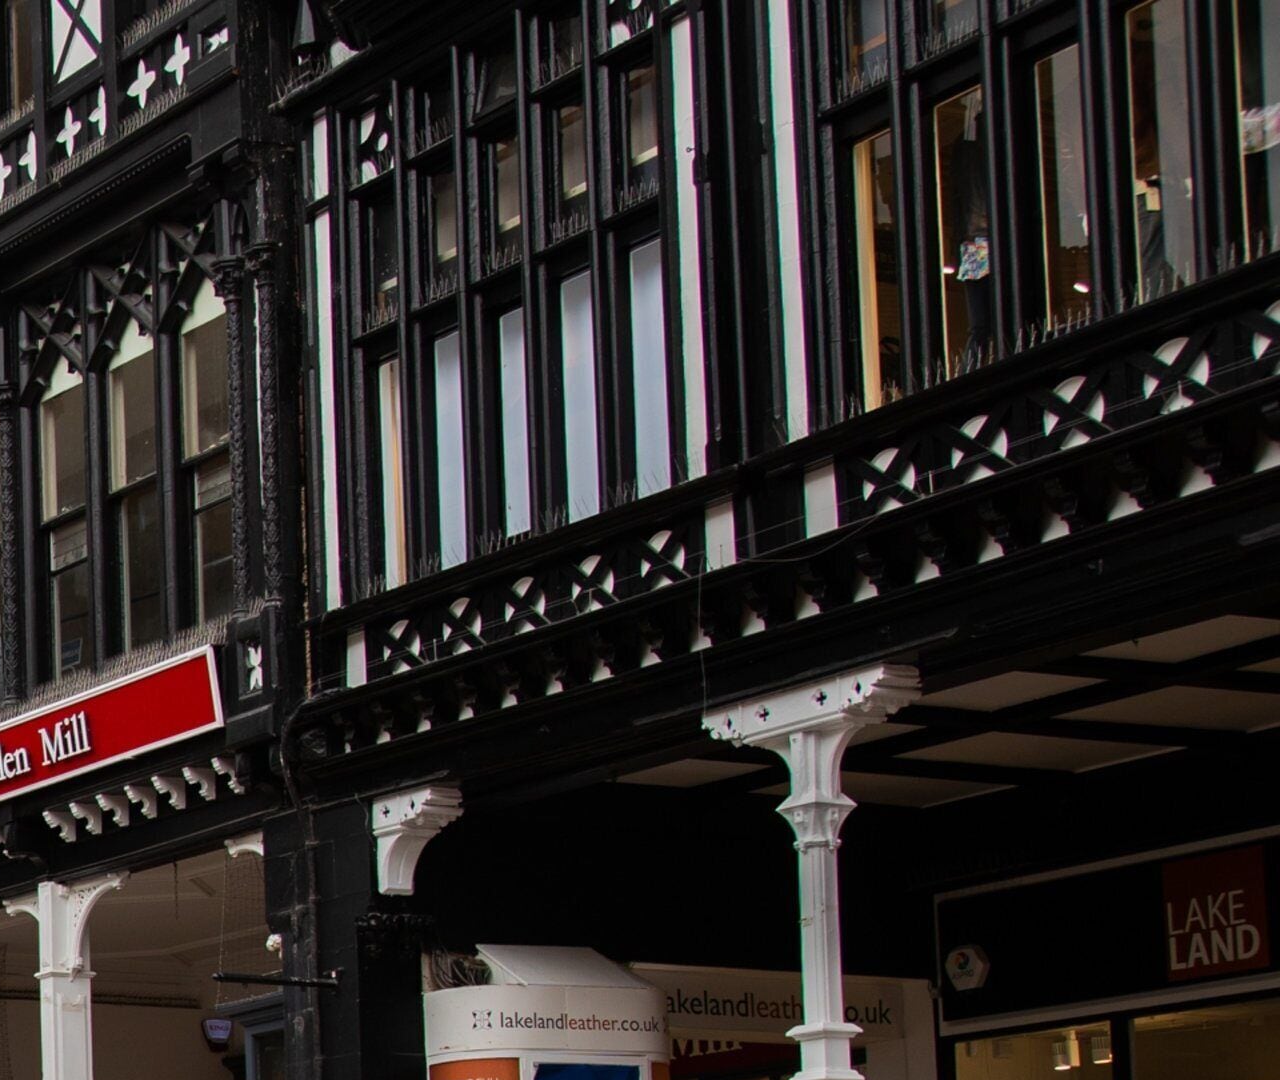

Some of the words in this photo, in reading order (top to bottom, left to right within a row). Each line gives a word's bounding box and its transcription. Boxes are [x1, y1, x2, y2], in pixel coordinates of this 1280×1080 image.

[37, 710, 92, 767] Mill
[1166, 888, 1248, 937] LAKE
[1168, 922, 1261, 972] LAND
[500, 1011, 660, 1033] lakelandleather.co.uk
